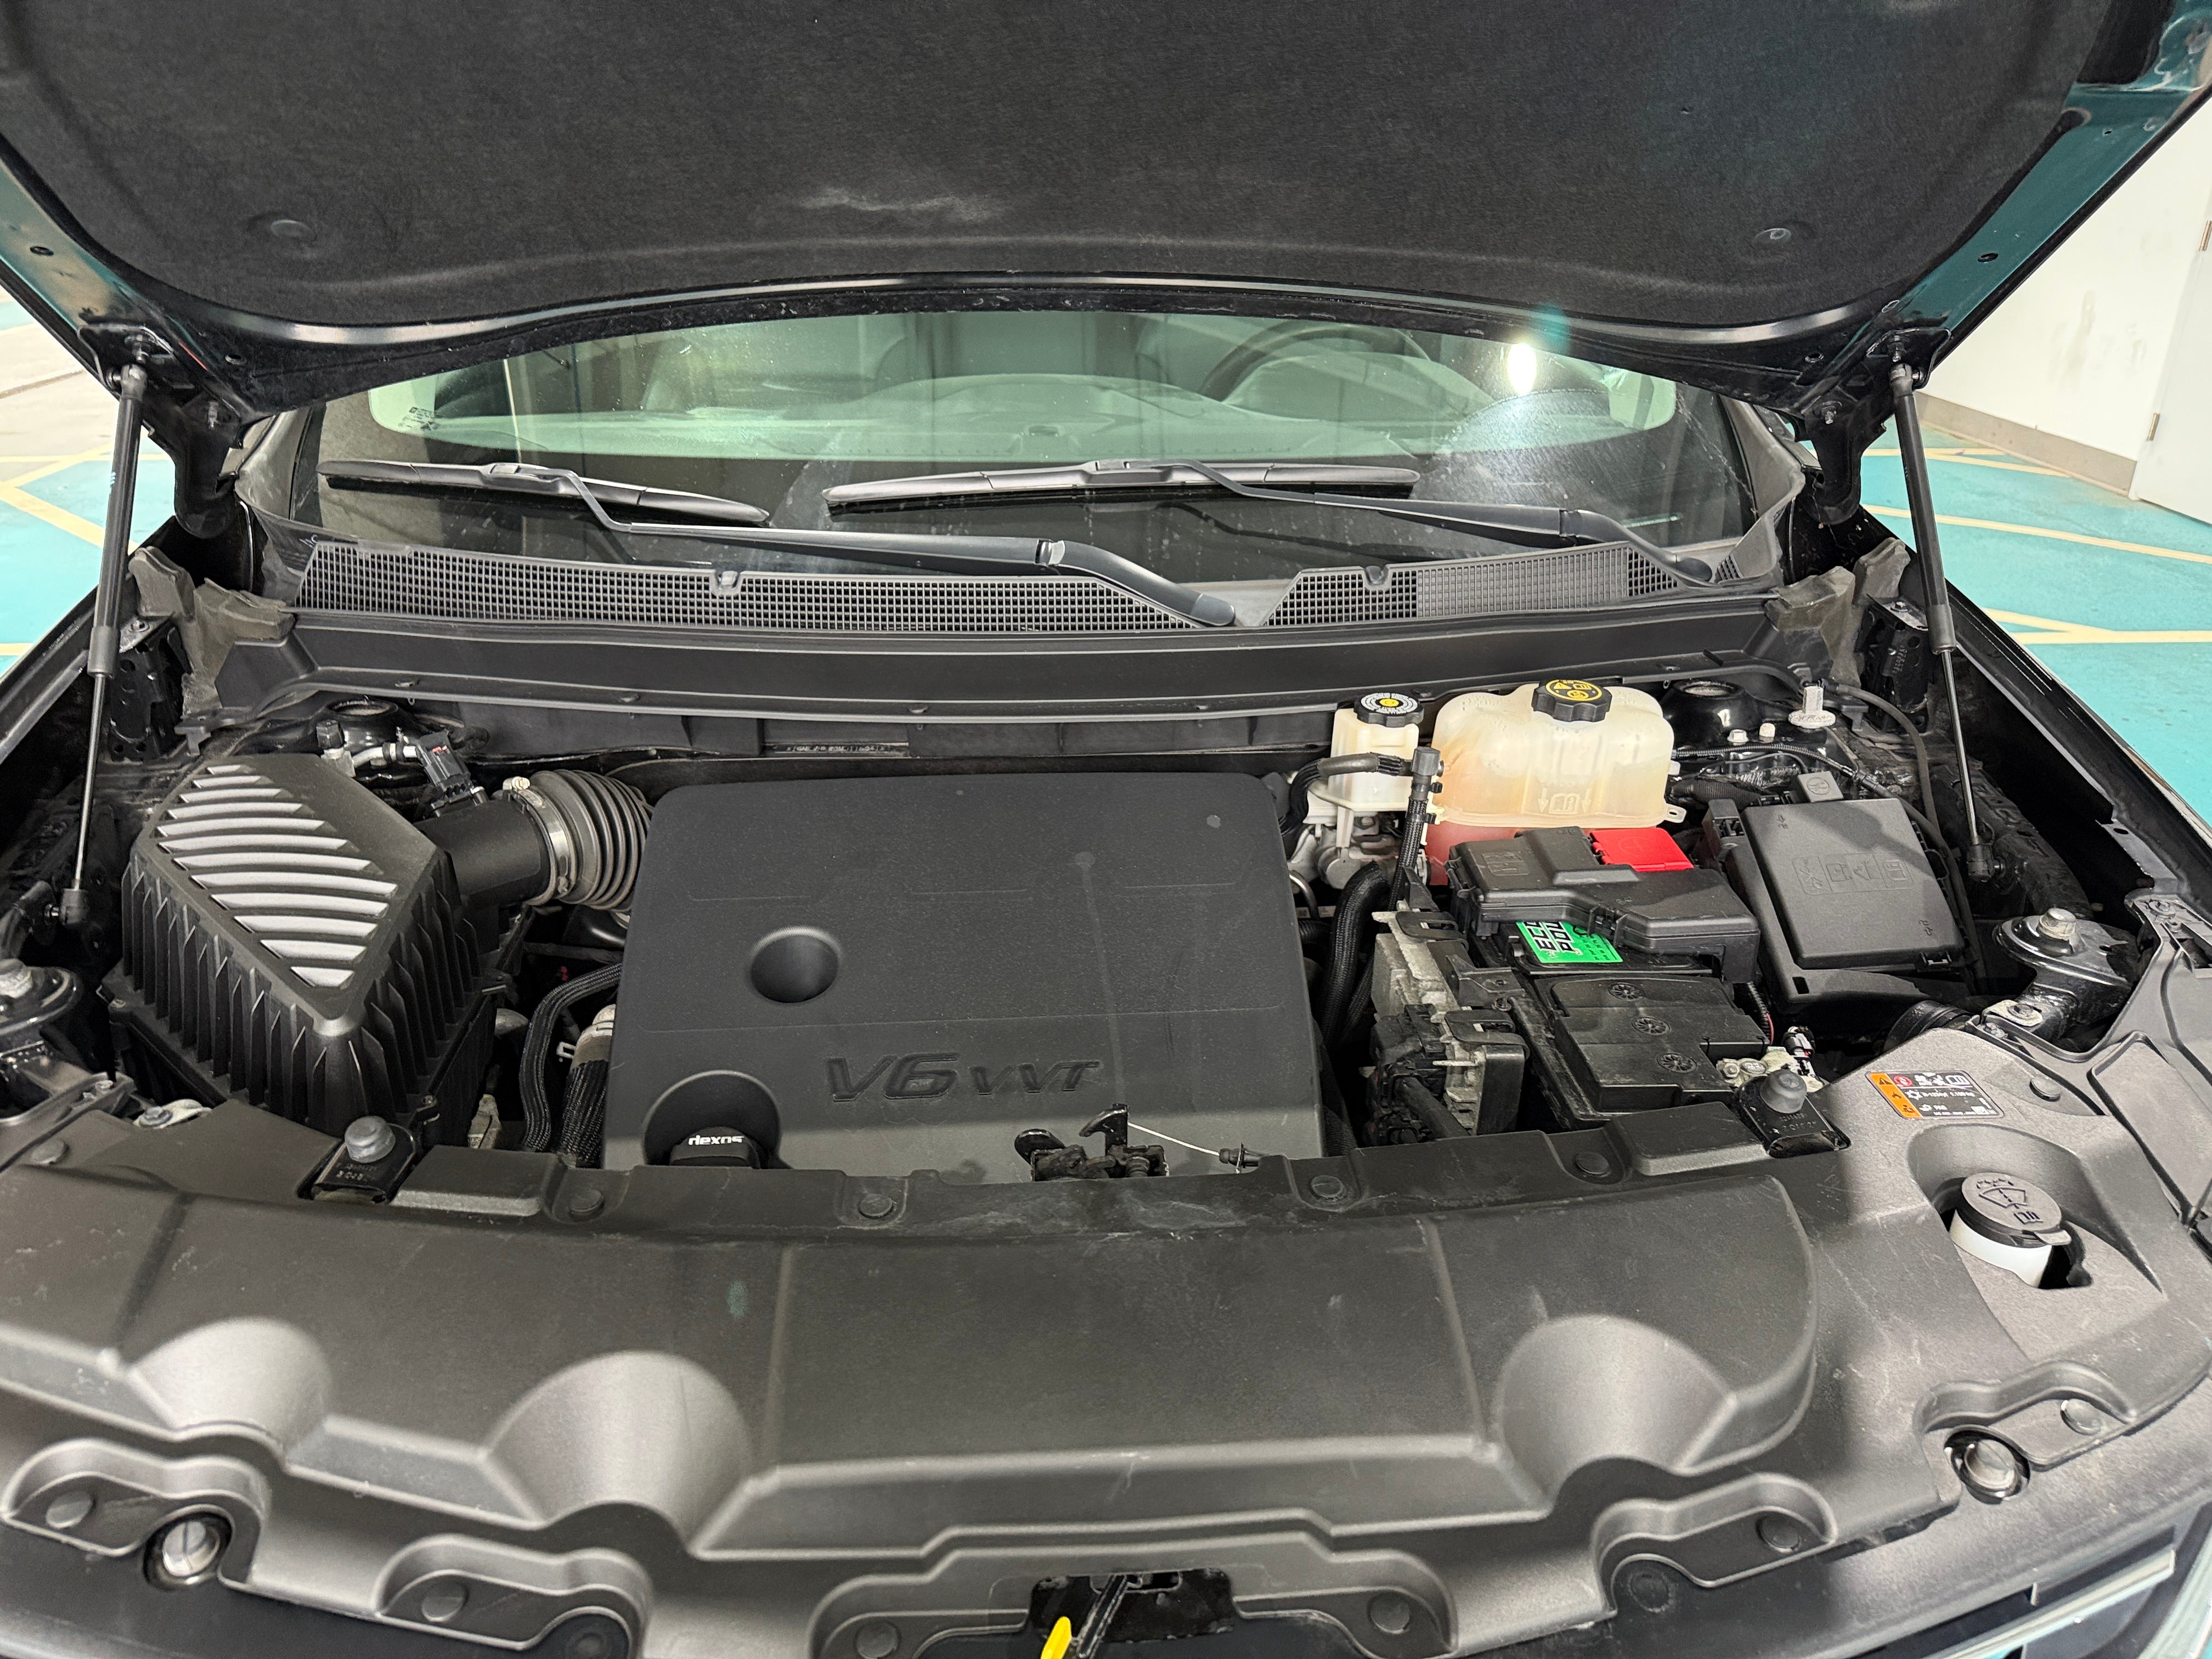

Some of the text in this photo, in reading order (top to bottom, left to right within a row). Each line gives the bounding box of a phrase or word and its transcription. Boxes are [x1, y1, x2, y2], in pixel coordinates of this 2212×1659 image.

[825, 1053, 1099, 1101] V6 VVT
[689, 1135, 745, 1146] dexos
